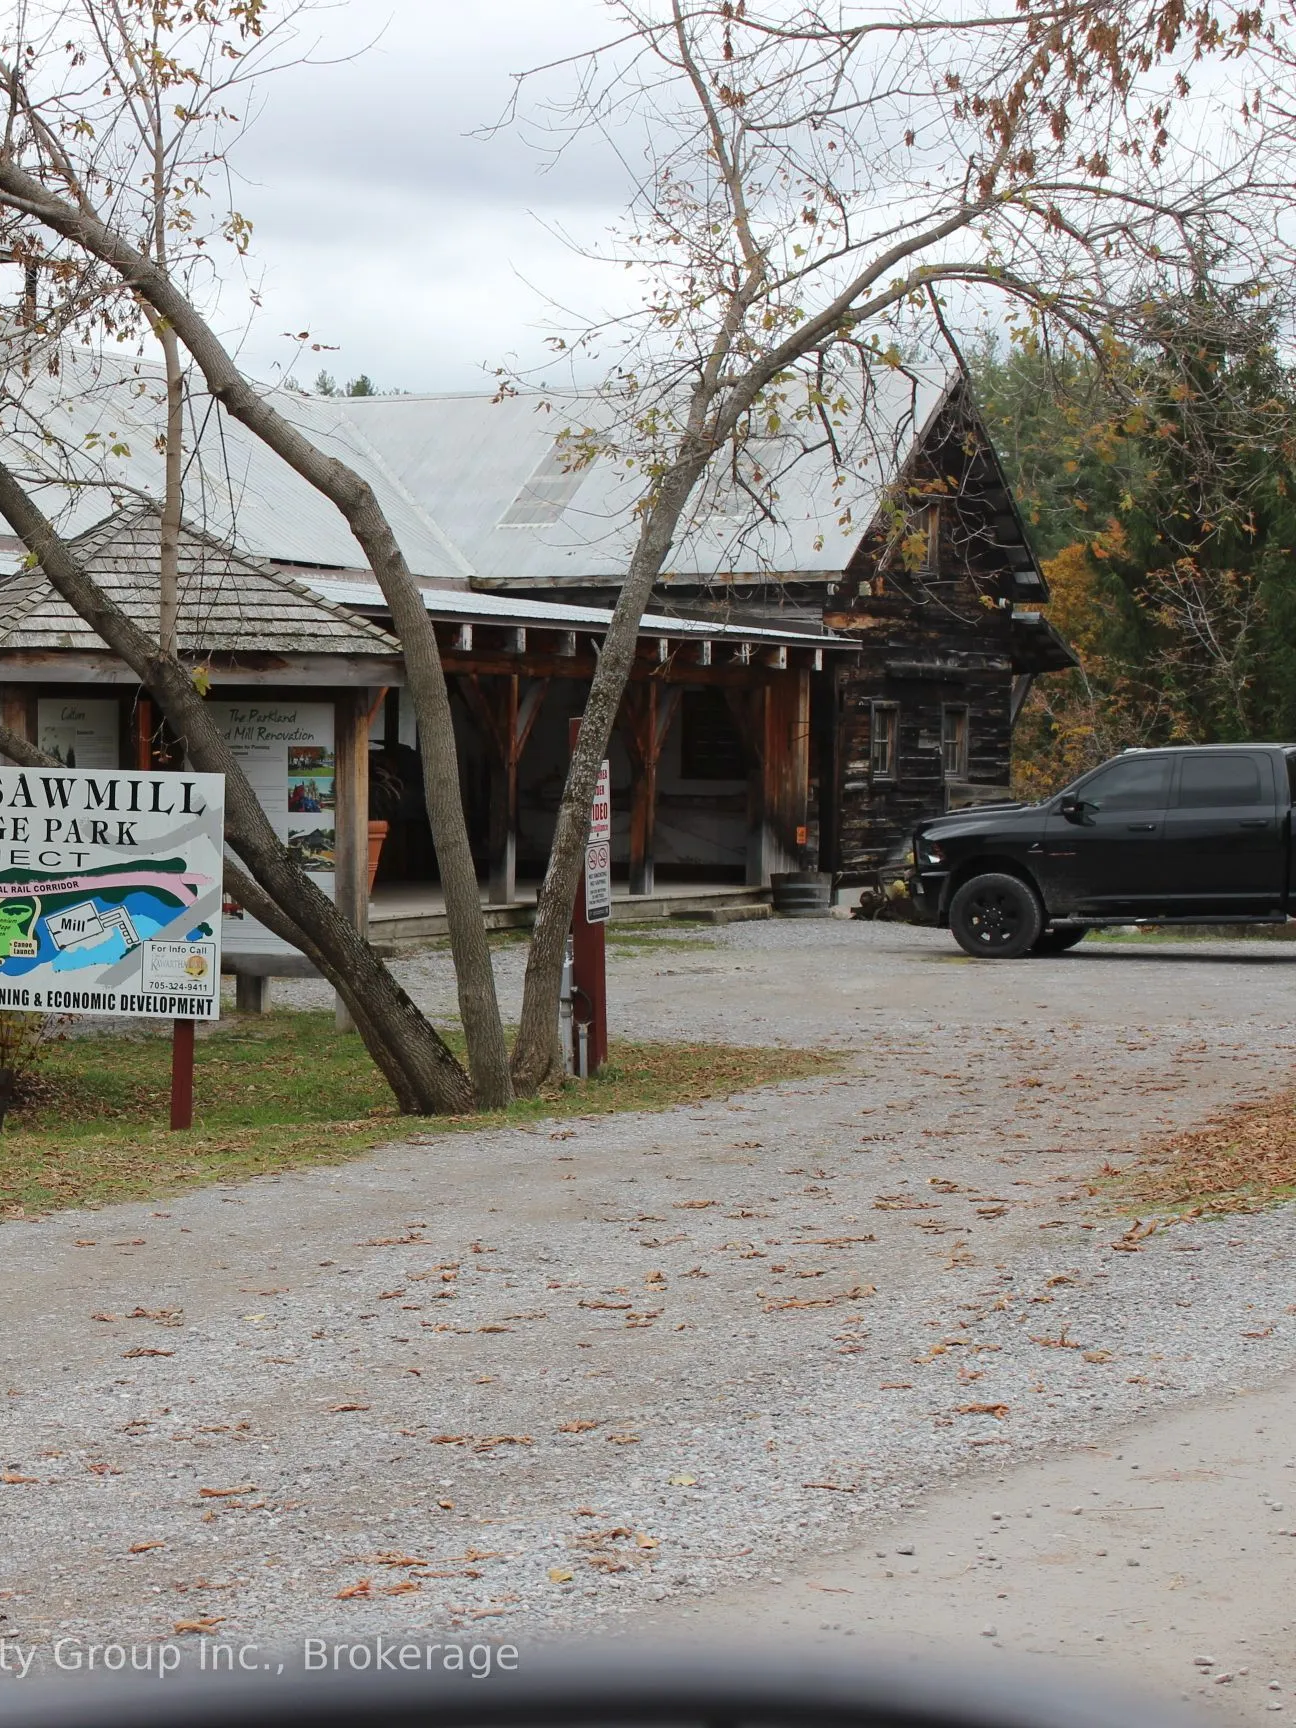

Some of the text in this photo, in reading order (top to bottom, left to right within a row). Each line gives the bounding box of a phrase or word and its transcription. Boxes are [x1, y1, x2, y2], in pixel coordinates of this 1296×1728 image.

[229, 708, 298, 724] The Parkland
[235, 727, 255, 740] Mill
[257, 726, 315, 741] Renovation
[592, 802, 608, 821] IDEO
[43, 817, 140, 847] PARK
[11, 885, 32, 894] RAIL
[33, 880, 80, 893] CORRIDOR
[61, 917, 86, 933] Mill
[13, 941, 33, 949] Canoe
[13, 948, 35, 956] Launch
[151, 944, 207, 955] For Info Call
[149, 981, 208, 992] 705-324-9411
[33, 992, 43, 1007] &
[47, 990, 116, 1011] ECONOMIC
[120, 993, 214, 1016] DEVELOPMENT
